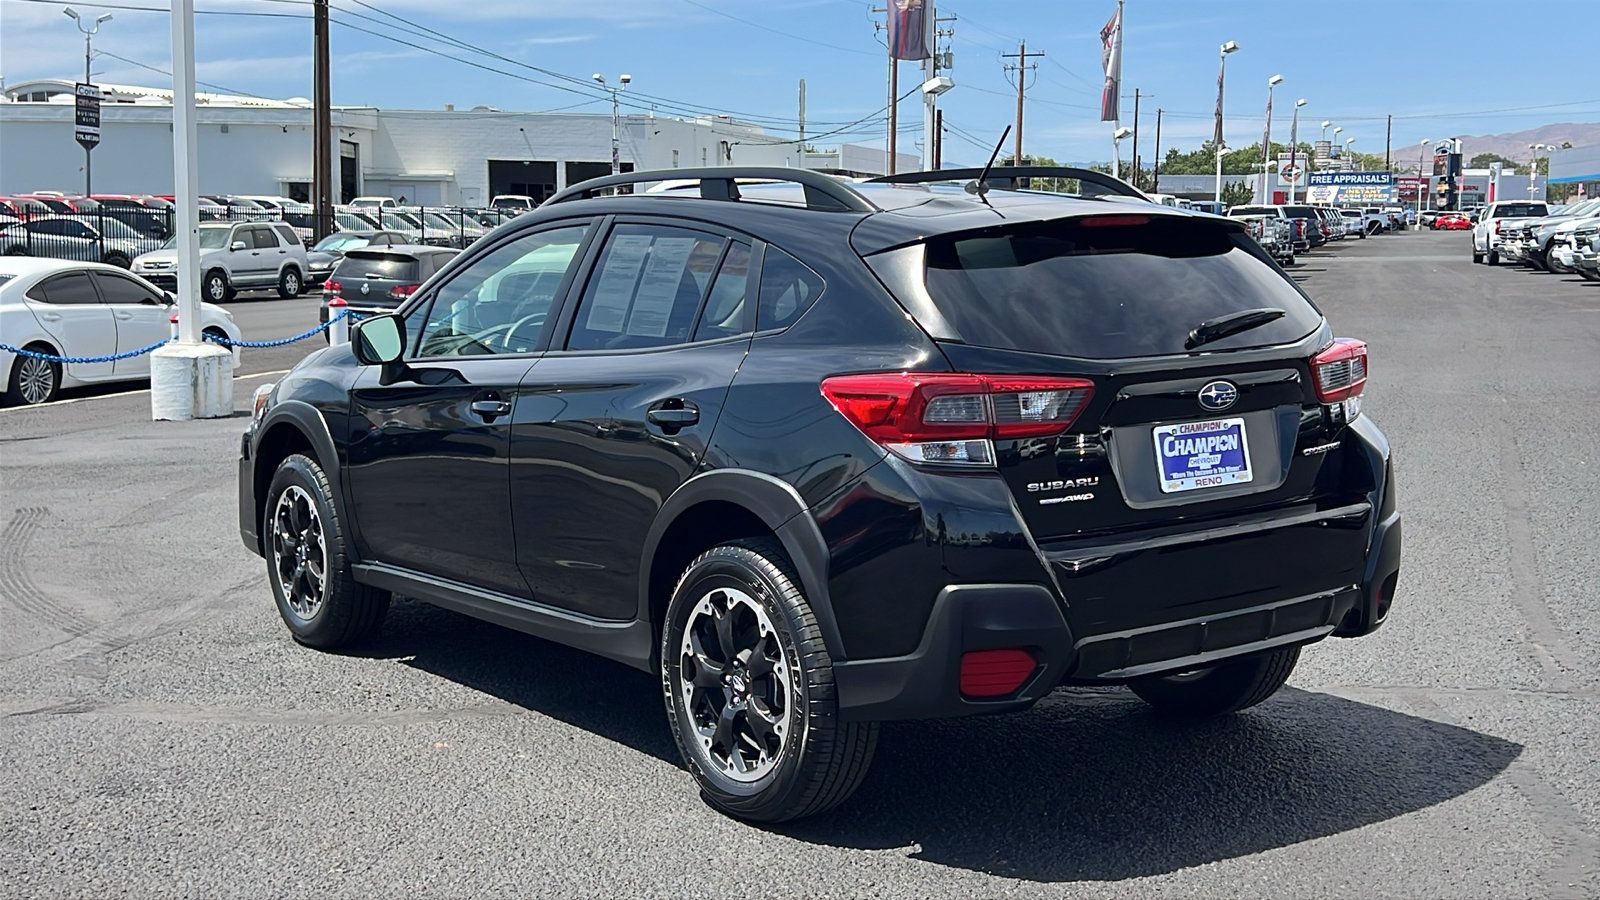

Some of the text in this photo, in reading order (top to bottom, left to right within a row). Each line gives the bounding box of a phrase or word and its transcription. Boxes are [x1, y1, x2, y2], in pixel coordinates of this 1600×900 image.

[1310, 175, 1333, 184] FREE
[1333, 174, 1390, 184] APPRAISALS!
[1180, 421, 1221, 434] CHAMPION
[1189, 455, 1220, 466] CHEVROLET
[1027, 476, 1099, 492] SUBARU
[1195, 476, 1223, 487] RENO
[1061, 492, 1095, 503] AWD
